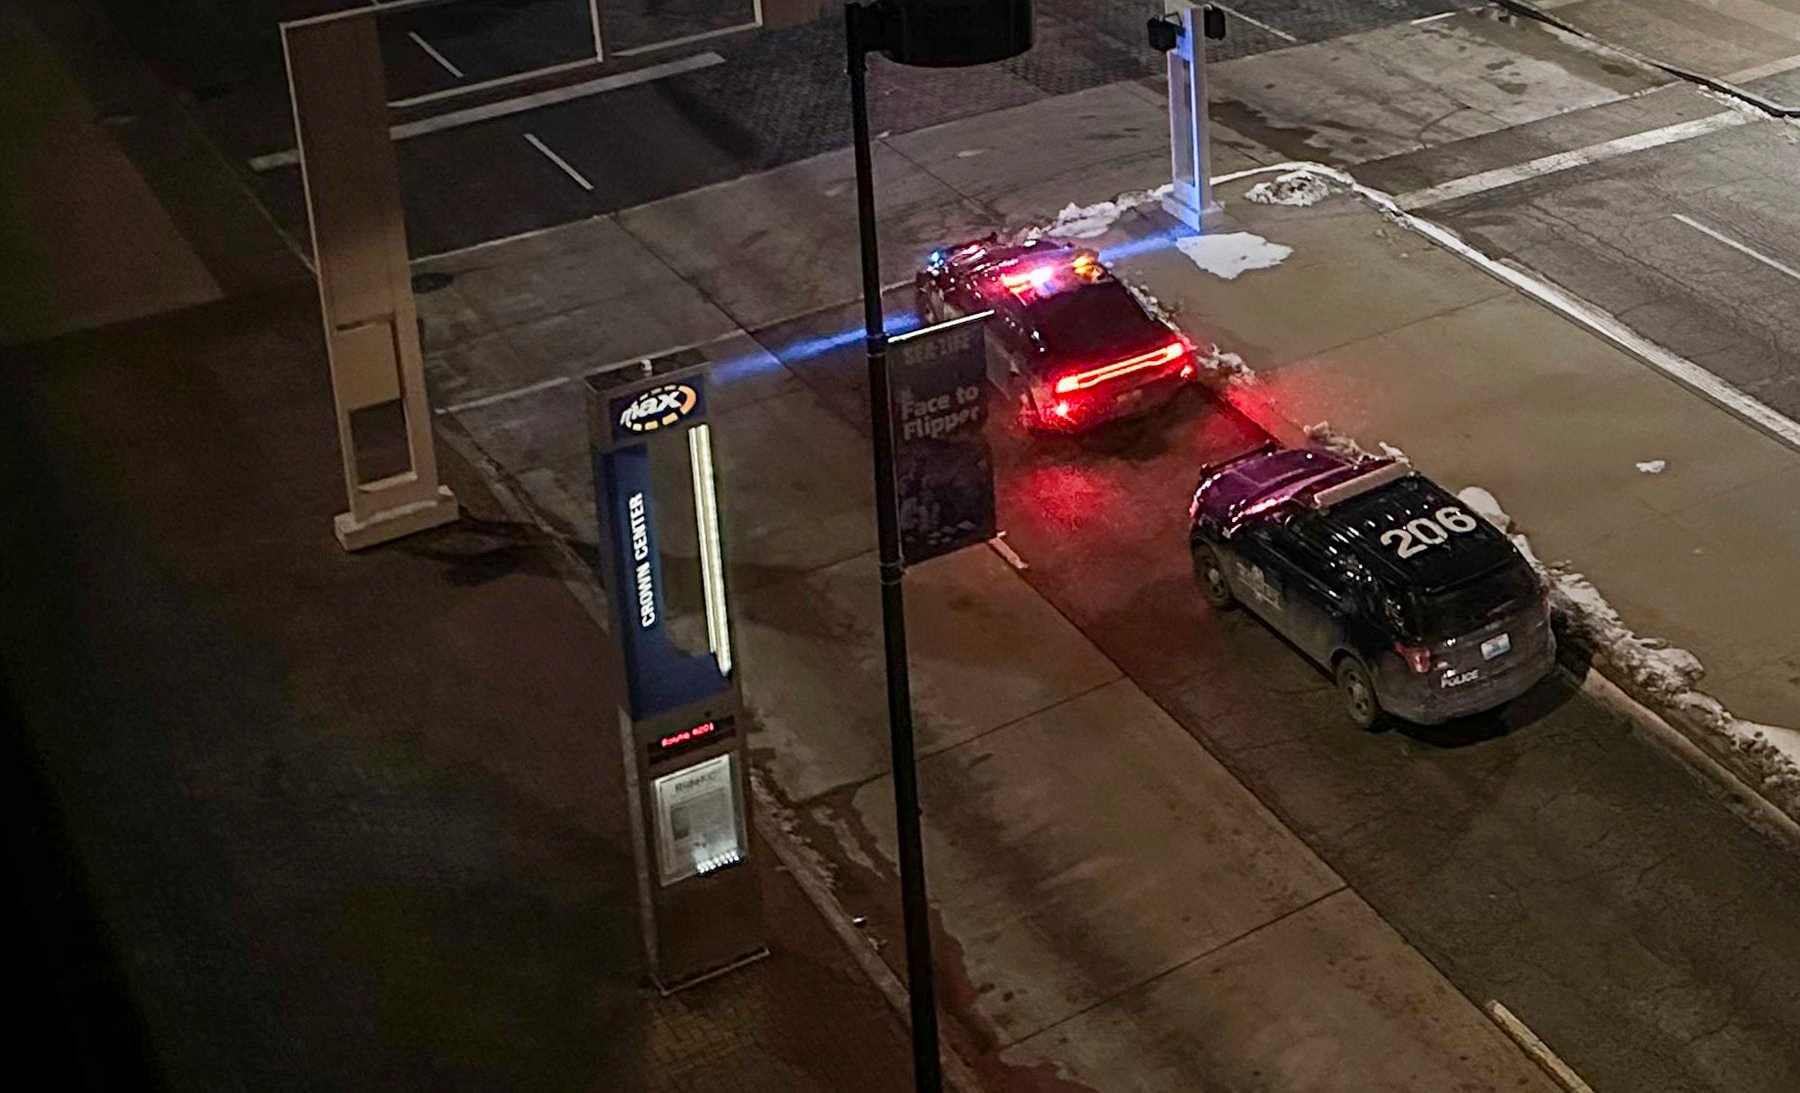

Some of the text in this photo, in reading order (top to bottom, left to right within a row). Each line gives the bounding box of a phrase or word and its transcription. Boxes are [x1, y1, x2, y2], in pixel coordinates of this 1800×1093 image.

[902, 385, 980, 421] Face to
[903, 405, 981, 441] Flipper
[1380, 506, 1478, 559] 206
[629, 493, 656, 628] CROWN CENTER
[1441, 668, 1479, 688] POLICE
